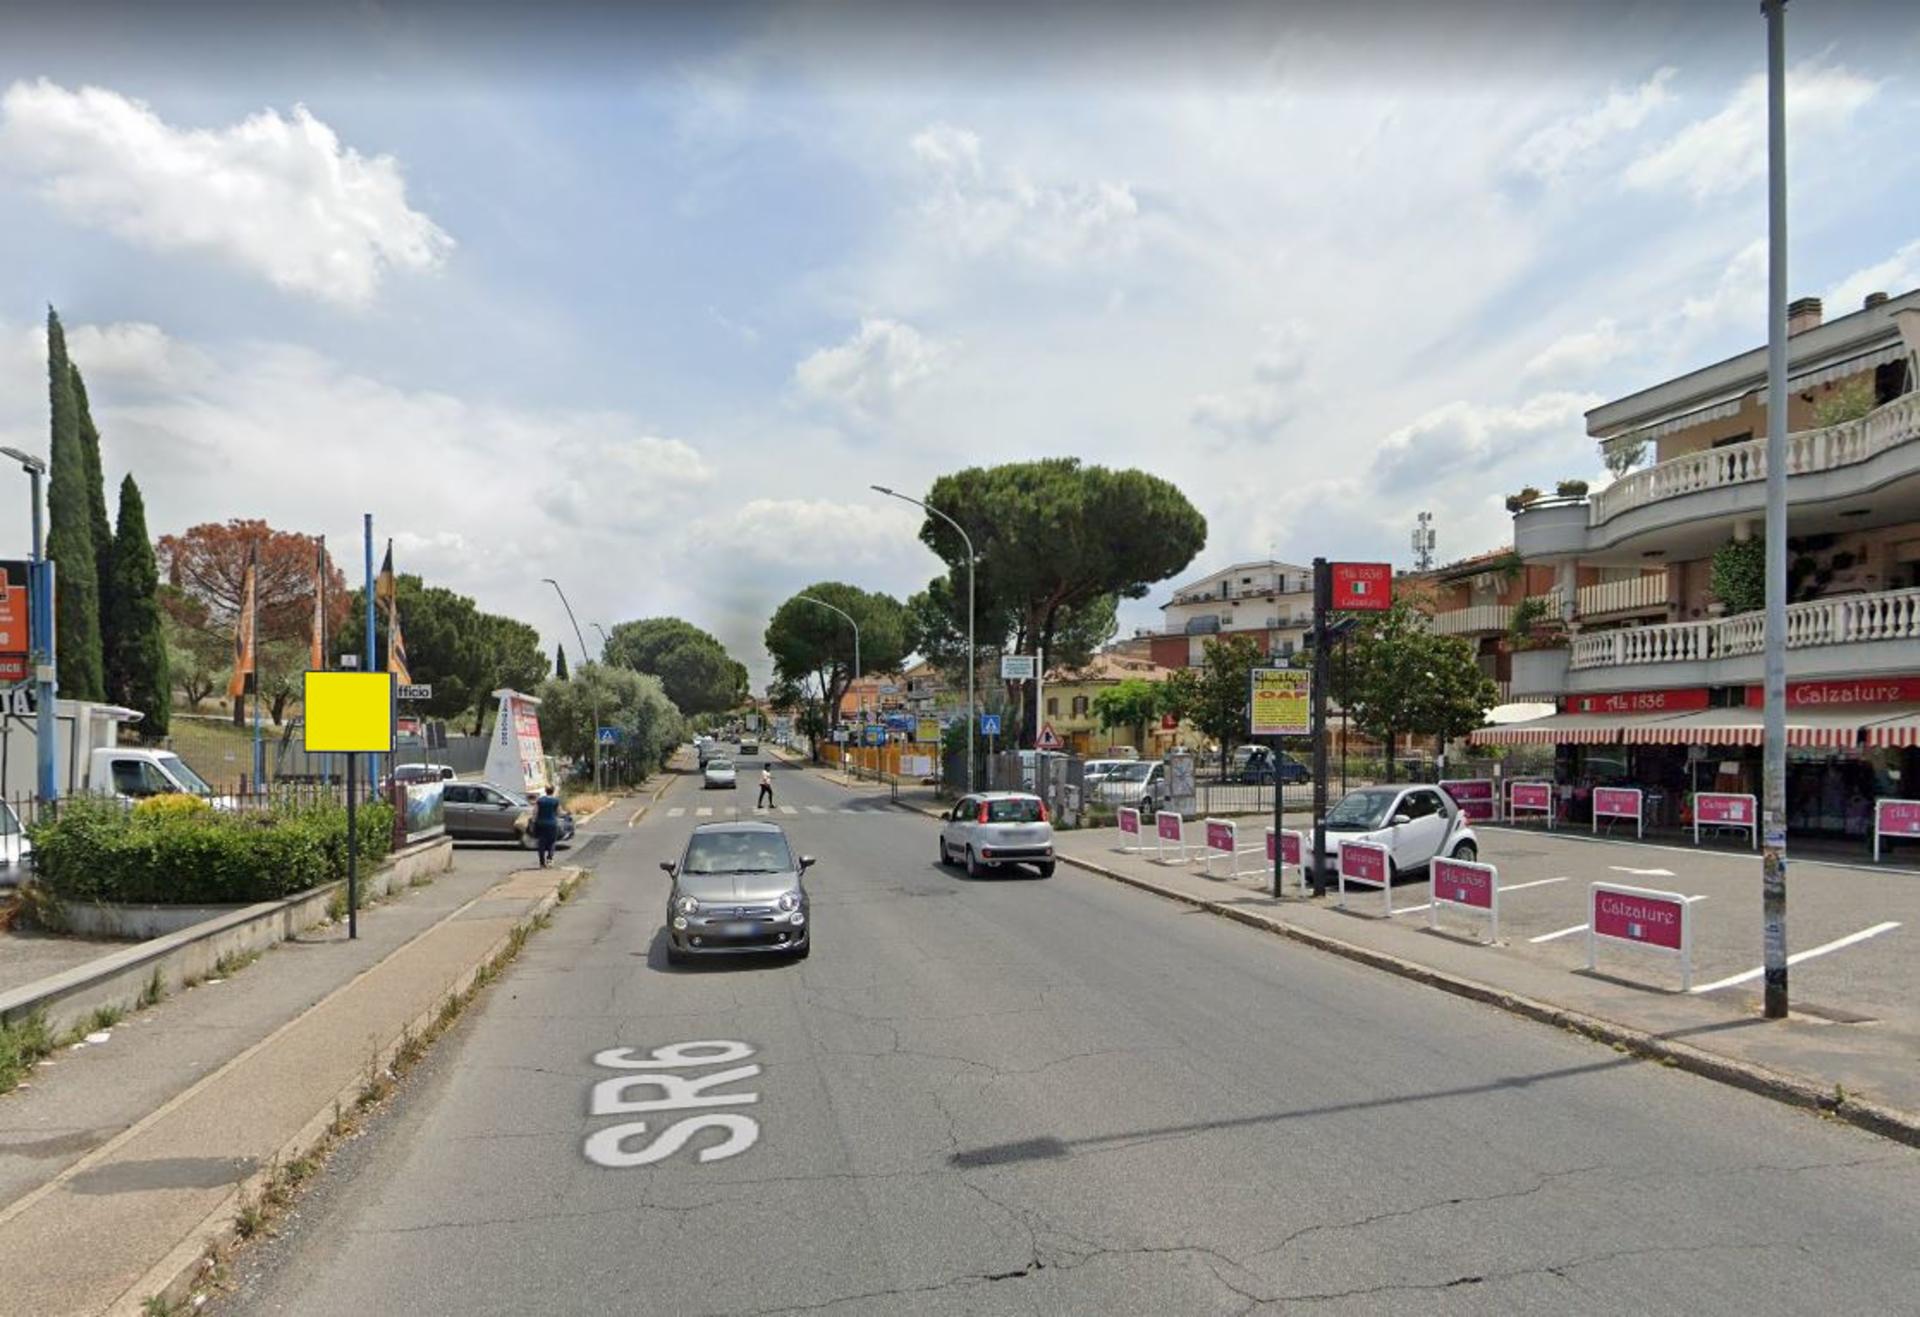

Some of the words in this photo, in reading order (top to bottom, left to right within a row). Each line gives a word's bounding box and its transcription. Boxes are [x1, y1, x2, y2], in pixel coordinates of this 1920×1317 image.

[1632, 693, 1665, 709] 1836
[1795, 685, 1901, 704] Calzature
[1601, 898, 1675, 925] Calzature
